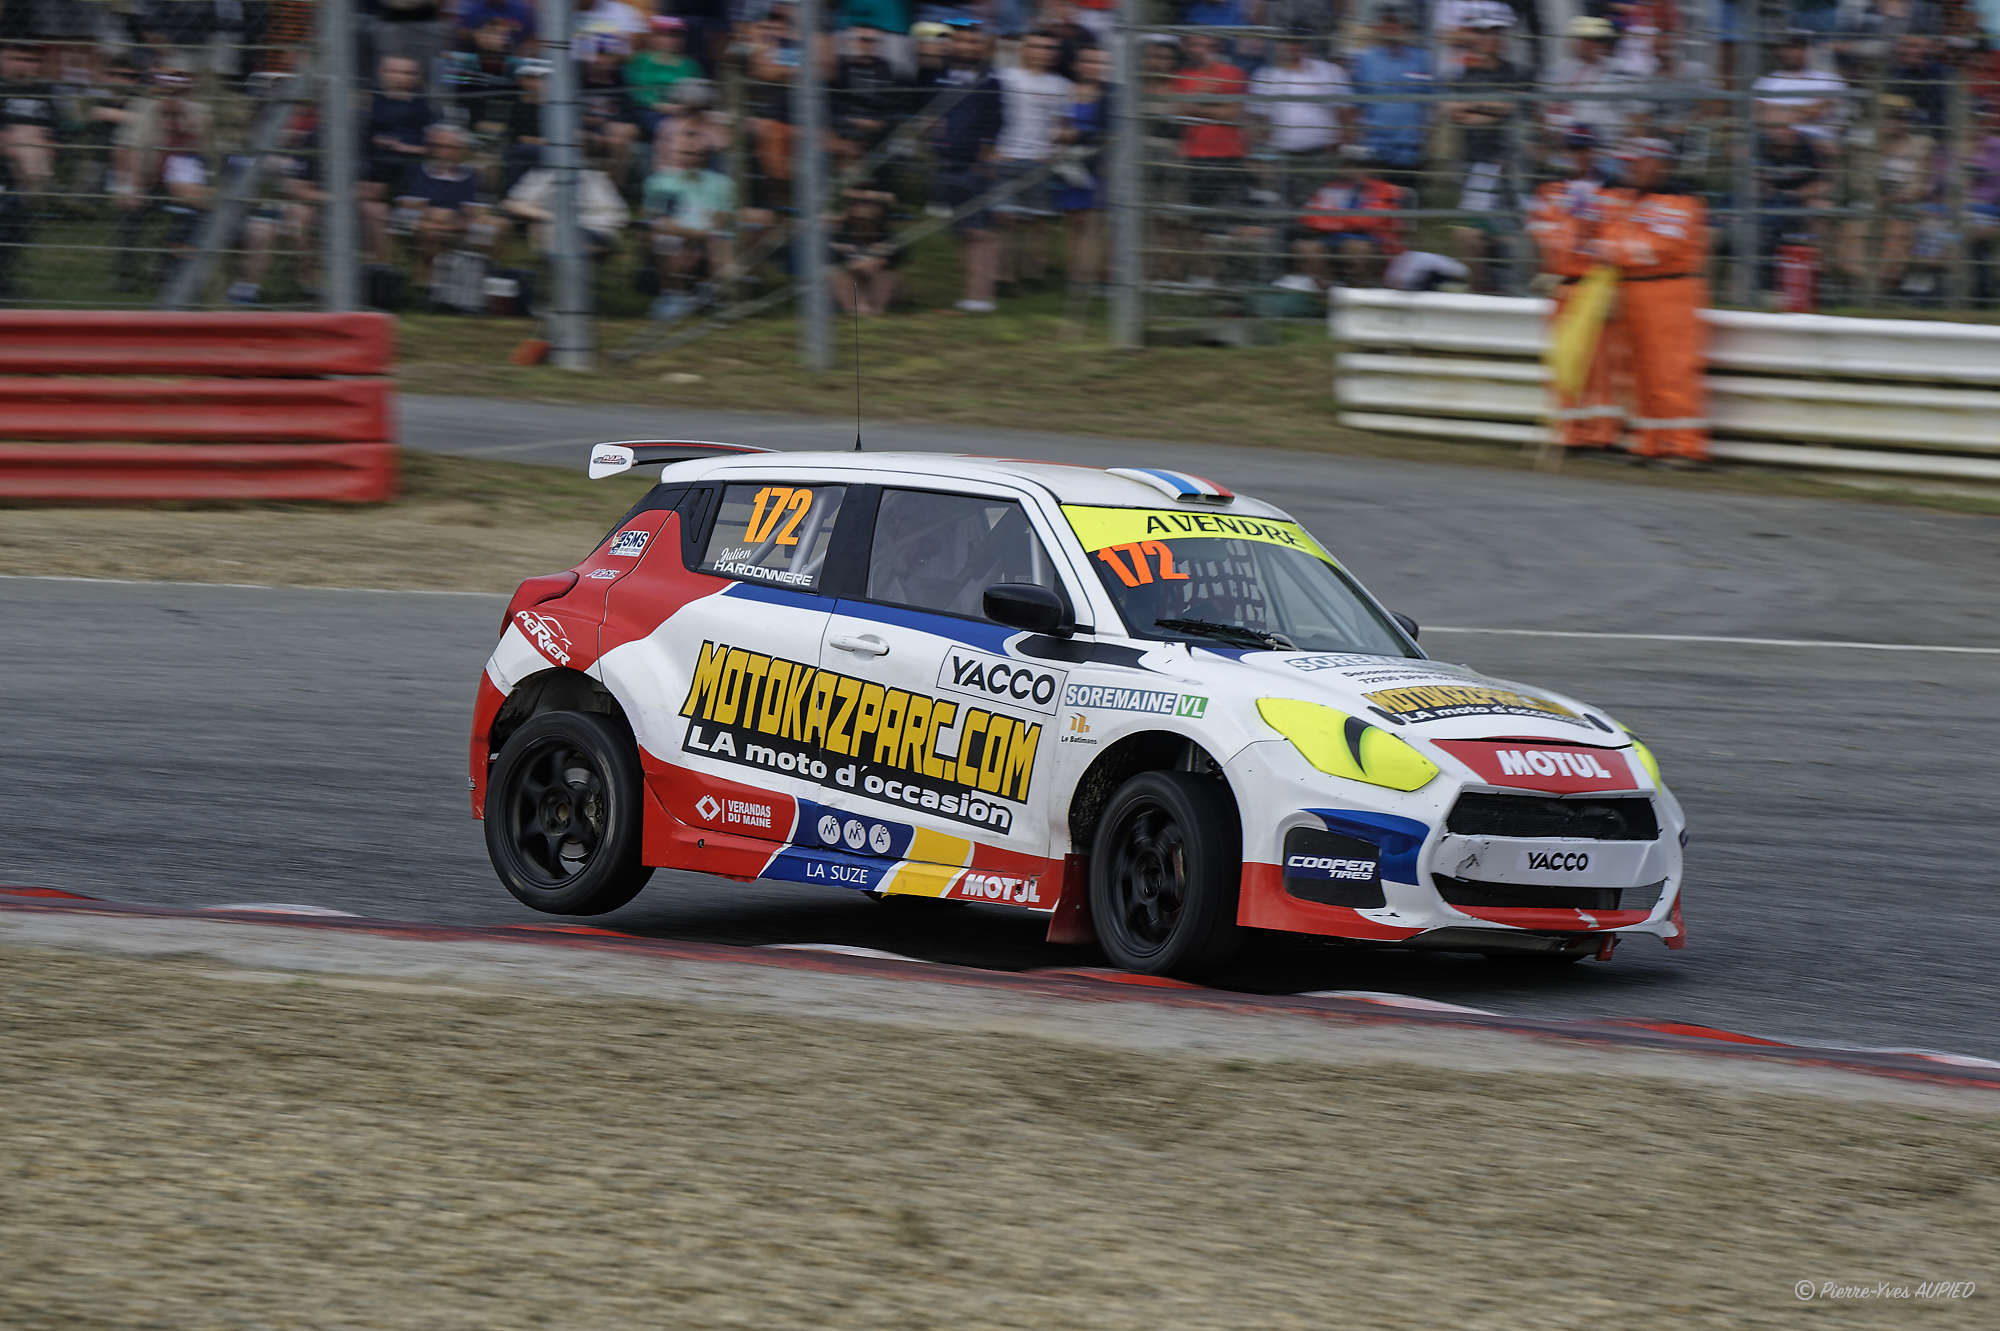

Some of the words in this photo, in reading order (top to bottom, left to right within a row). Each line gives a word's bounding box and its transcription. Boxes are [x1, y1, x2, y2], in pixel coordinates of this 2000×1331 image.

[743, 487, 813, 545] 172
[720, 547, 752, 562] Julien
[1097, 540, 1190, 587] 172
[713, 560, 814, 586] HARDONNIERE
[953, 656, 1055, 705] YACCO
[1067, 685, 1177, 714] SOREMAINE
[1181, 694, 1208, 719] VL
[683, 643, 1041, 801] MOTOKAZPARC.COM
[688, 725, 737, 757] LA
[745, 743, 828, 780] moto
[1496, 750, 1612, 778] MOTUL
[727, 800, 771, 818] VERANDAS
[727, 812, 741, 824] DU
[742, 815, 772, 828] MAINE
[806, 862, 825, 878] LA
[830, 866, 868, 884] SUZE
[1287, 855, 1377, 872] COOPER
[1328, 869, 1374, 880] TIRES
[1528, 852, 1588, 871] YACCO
